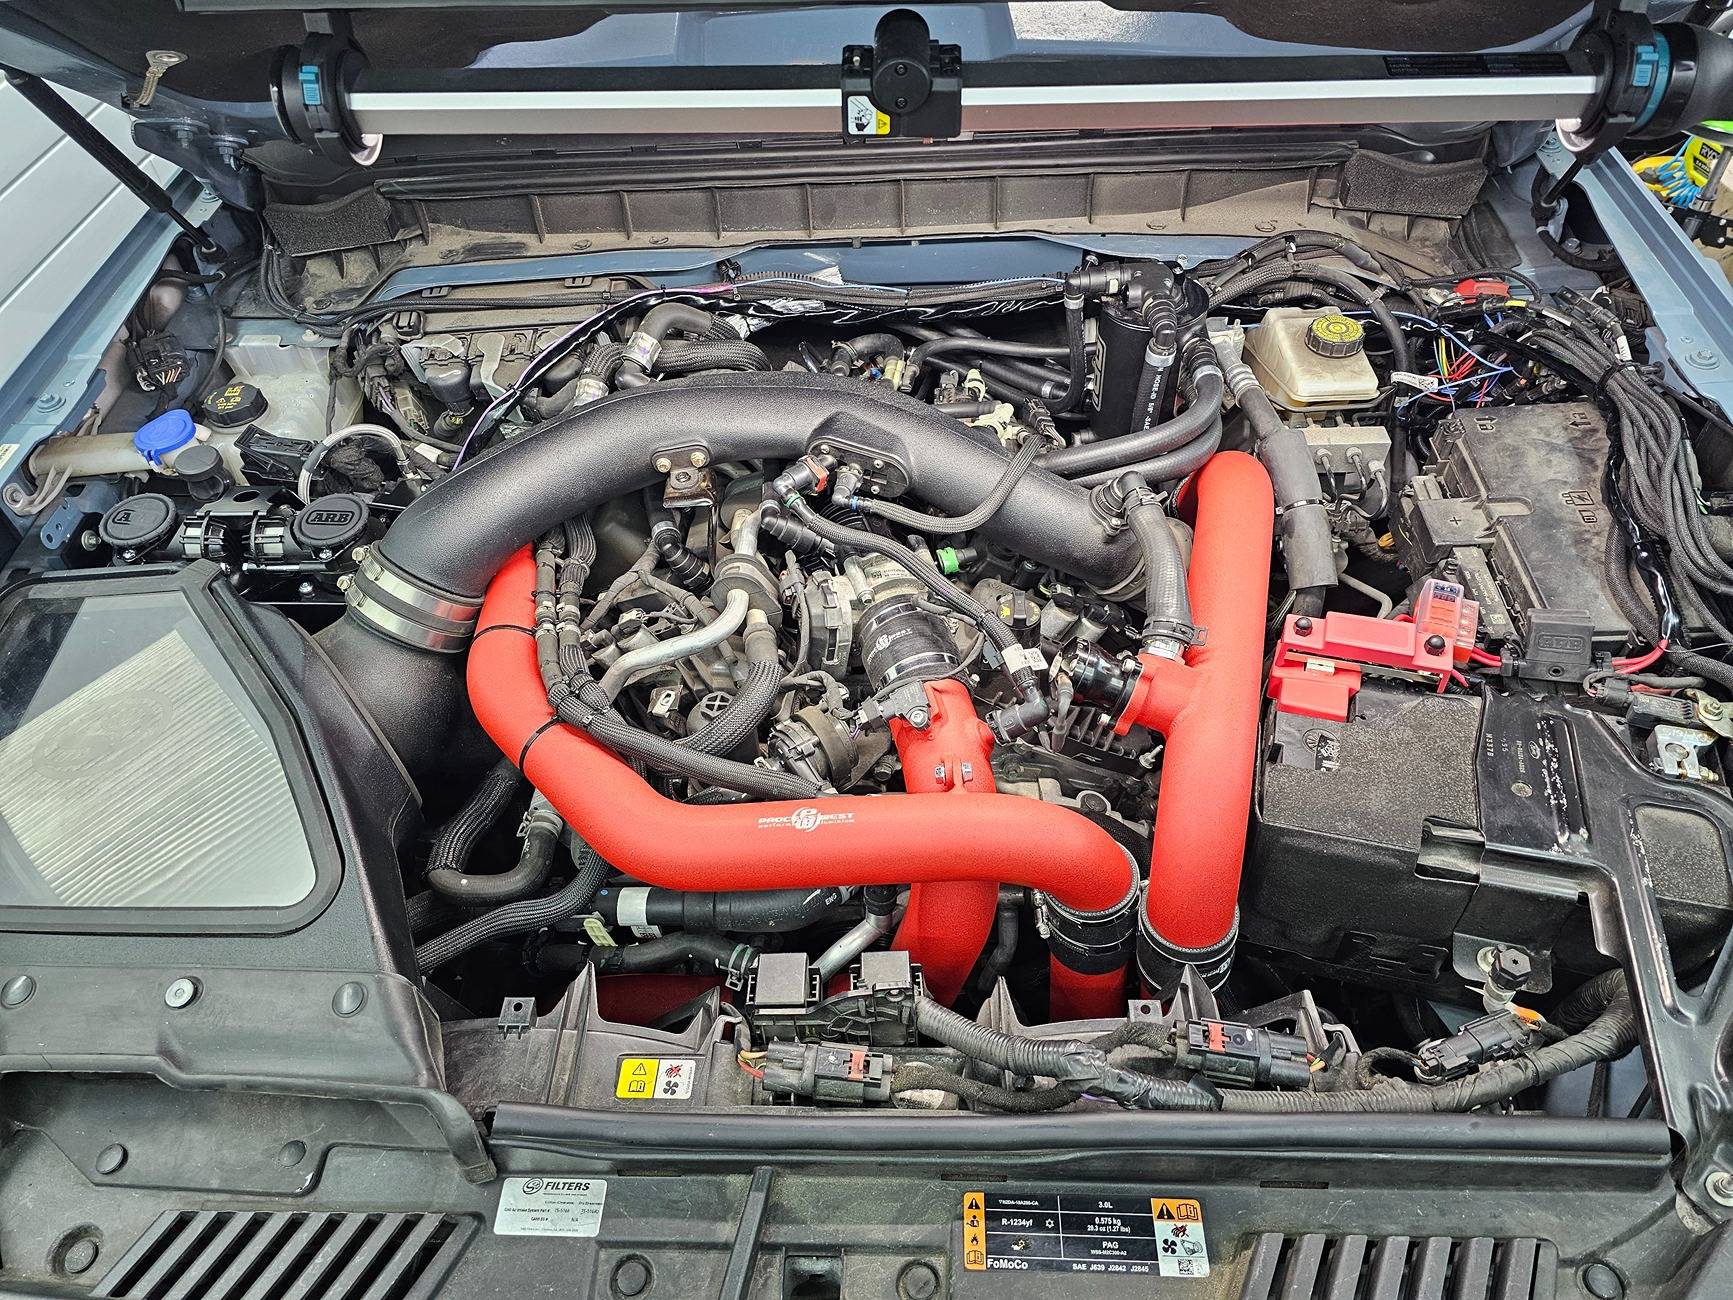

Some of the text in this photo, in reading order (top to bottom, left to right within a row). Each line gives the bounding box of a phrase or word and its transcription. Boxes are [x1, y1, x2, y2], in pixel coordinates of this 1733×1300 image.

[310, 511, 351, 524] ARB
[825, 893, 837, 906] ENG
[544, 1181, 591, 1191] FILTERS
[1098, 1201, 1113, 1209] 3.0L
[1001, 1218, 1033, 1227] R-1234yf
[1095, 1217, 1122, 1227] 0.575 kg
[1102, 1241, 1119, 1249] PAG
[987, 1259, 1029, 1270] FoMoCo
[1072, 1263, 1087, 1271] SAE
